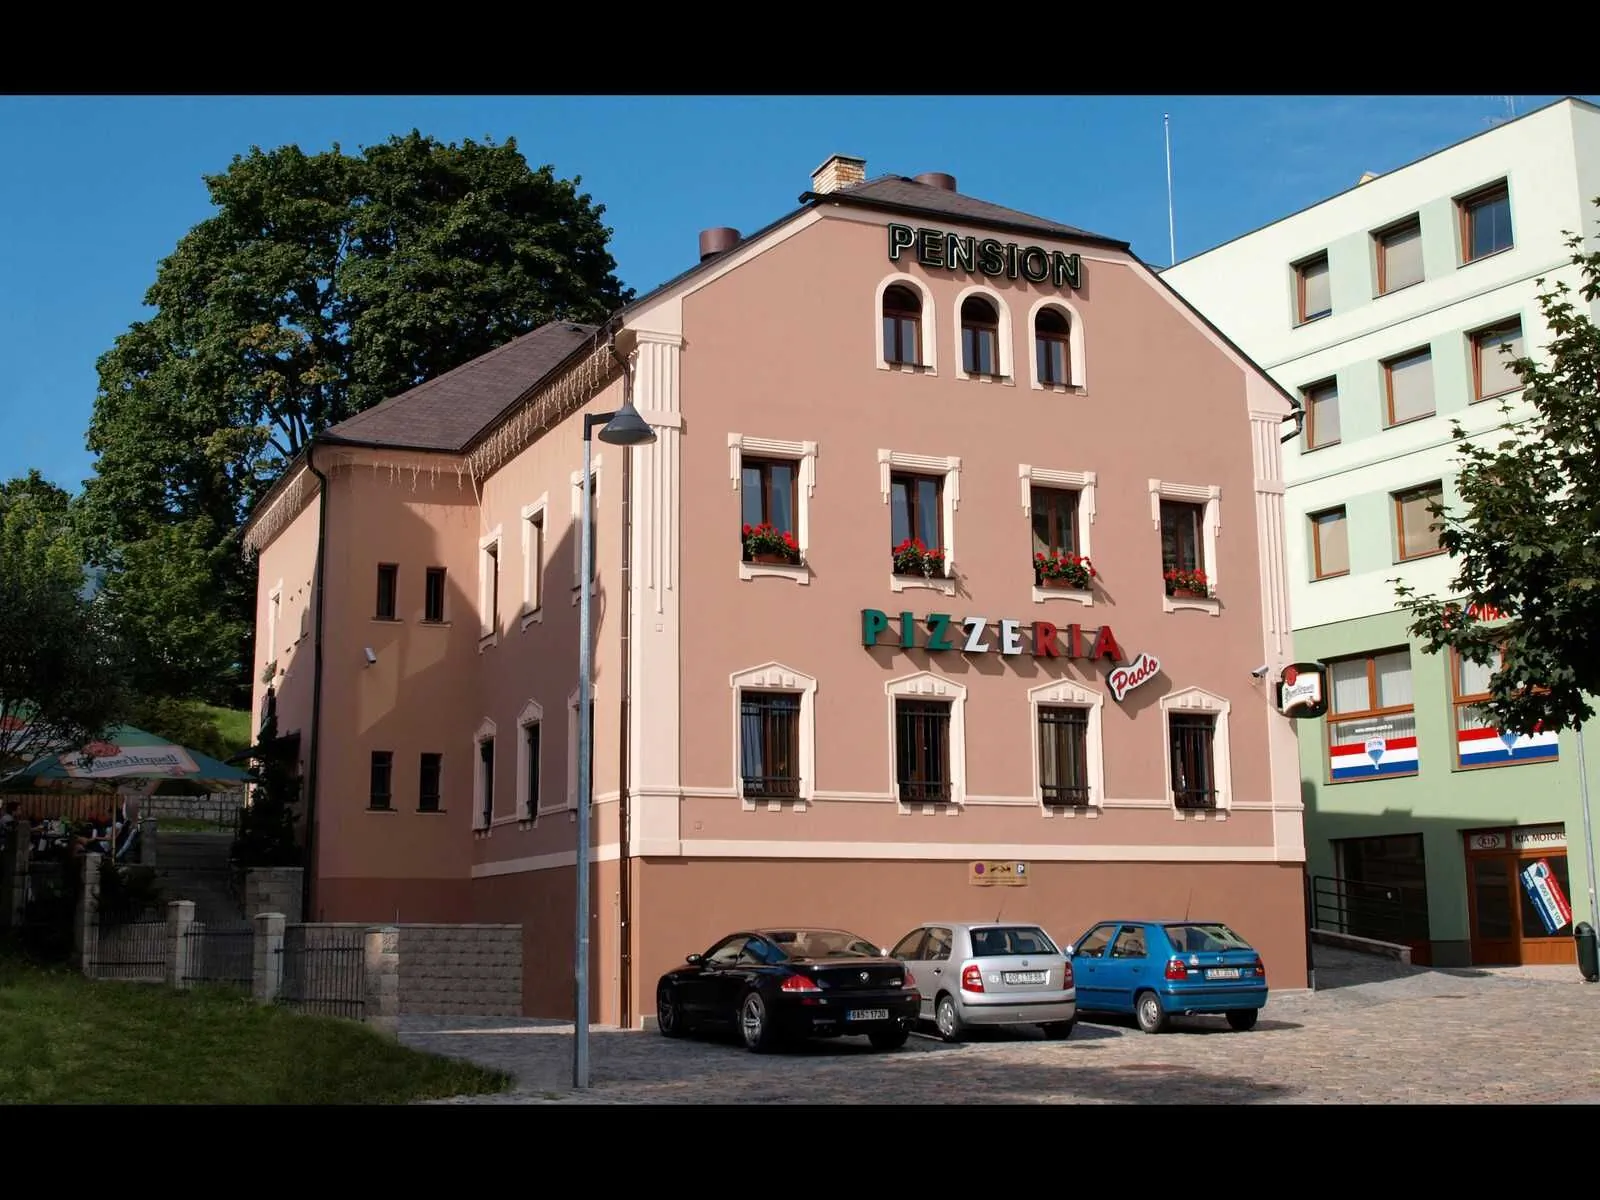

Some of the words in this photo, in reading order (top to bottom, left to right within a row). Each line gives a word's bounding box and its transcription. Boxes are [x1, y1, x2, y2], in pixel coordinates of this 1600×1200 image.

[887, 223, 1081, 289] PENSION
[862, 608, 1122, 661] PIZZERIA
[1112, 655, 1158, 697] Paolo
[1514, 833, 1529, 843] KIA
